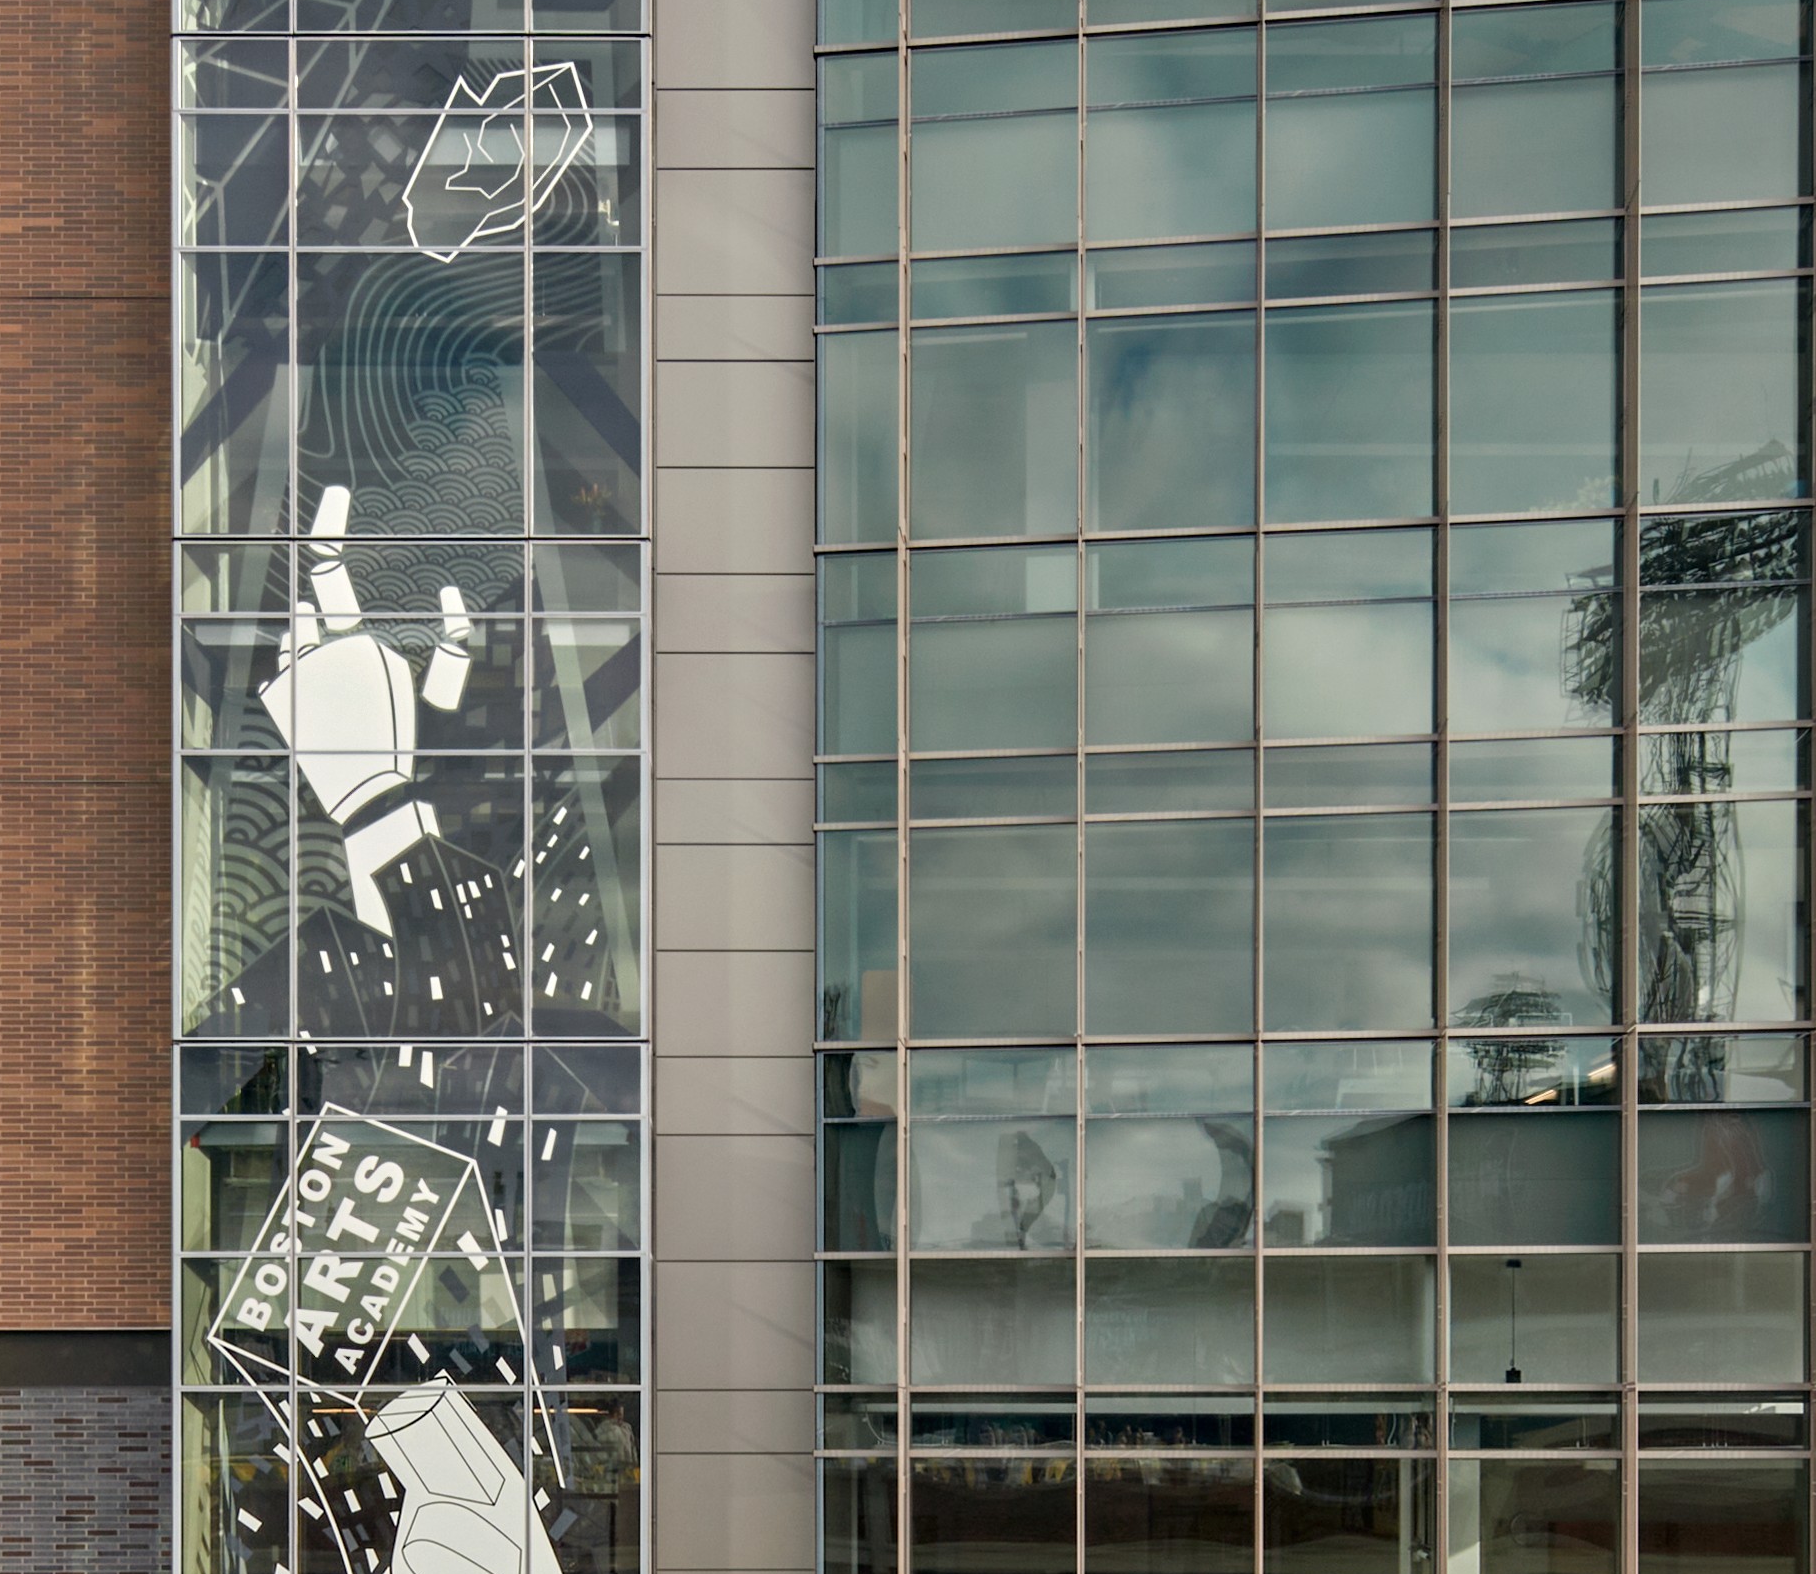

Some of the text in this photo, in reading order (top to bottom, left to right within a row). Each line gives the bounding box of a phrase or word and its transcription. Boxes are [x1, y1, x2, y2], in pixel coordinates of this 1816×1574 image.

[236, 1131, 351, 1332] BOSTON
[284, 1154, 406, 1358] ARTS
[332, 1177, 442, 1376] ACADEMY
